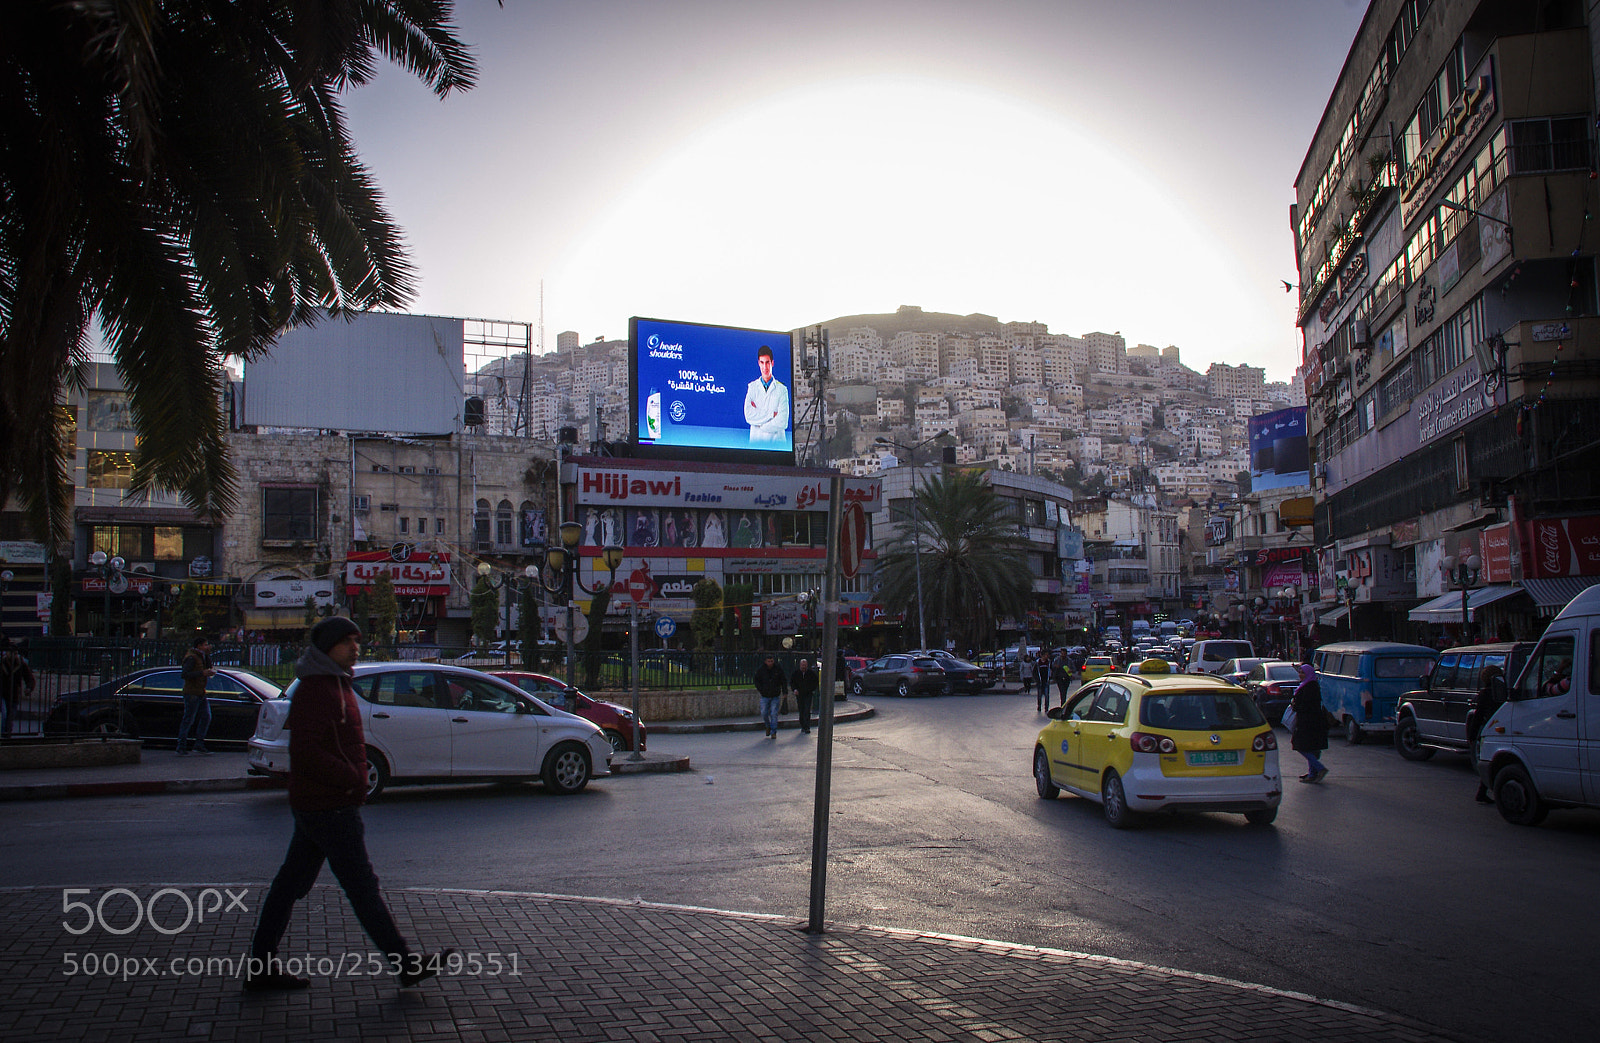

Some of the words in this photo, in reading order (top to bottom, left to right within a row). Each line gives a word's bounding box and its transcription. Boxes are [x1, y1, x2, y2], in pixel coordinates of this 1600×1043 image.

[649, 349, 683, 360] shoulders
[678, 370, 699, 381] 100%
[694, 382, 706, 392] من
[706, 383, 726, 394] حماية
[1435, 399, 1468, 434] Commercial
[1467, 391, 1485, 417] Bank
[583, 472, 681, 500] Hijjawi
[684, 492, 722, 503] Fashion
